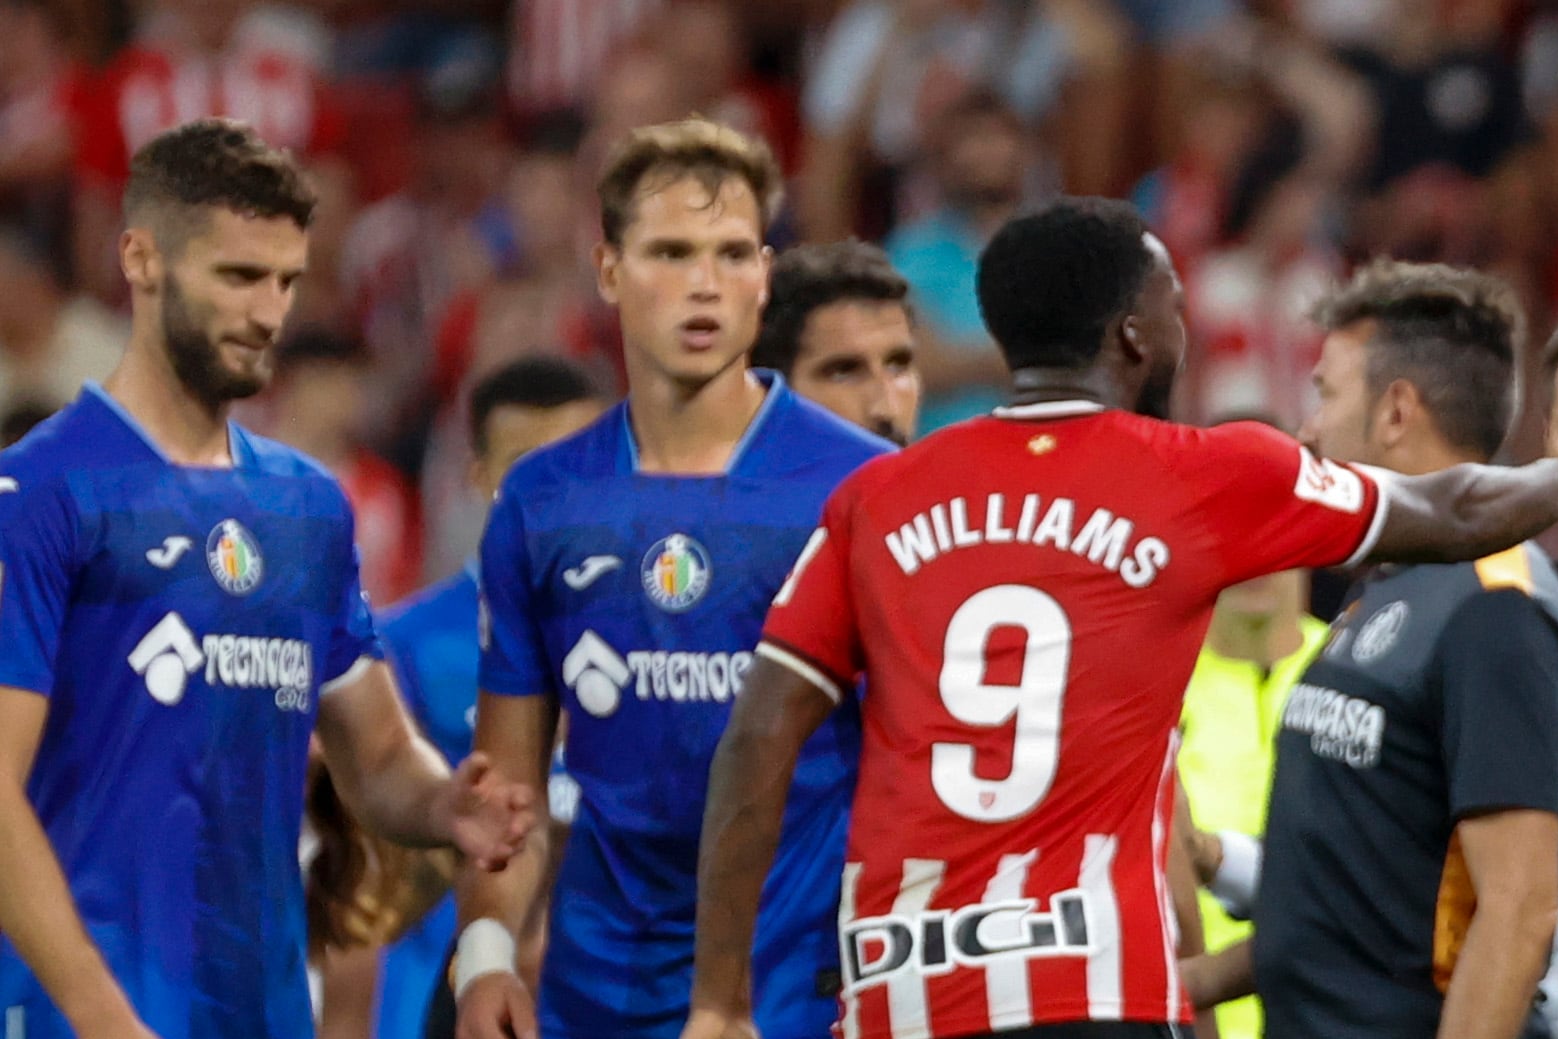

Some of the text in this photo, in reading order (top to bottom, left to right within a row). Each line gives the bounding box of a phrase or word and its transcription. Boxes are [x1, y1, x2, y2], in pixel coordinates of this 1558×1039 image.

[885, 493, 1170, 588] WILLIAMS
[627, 650, 752, 702] TECNOC
[931, 583, 1072, 822] 9
[845, 891, 1092, 986] DIGI
